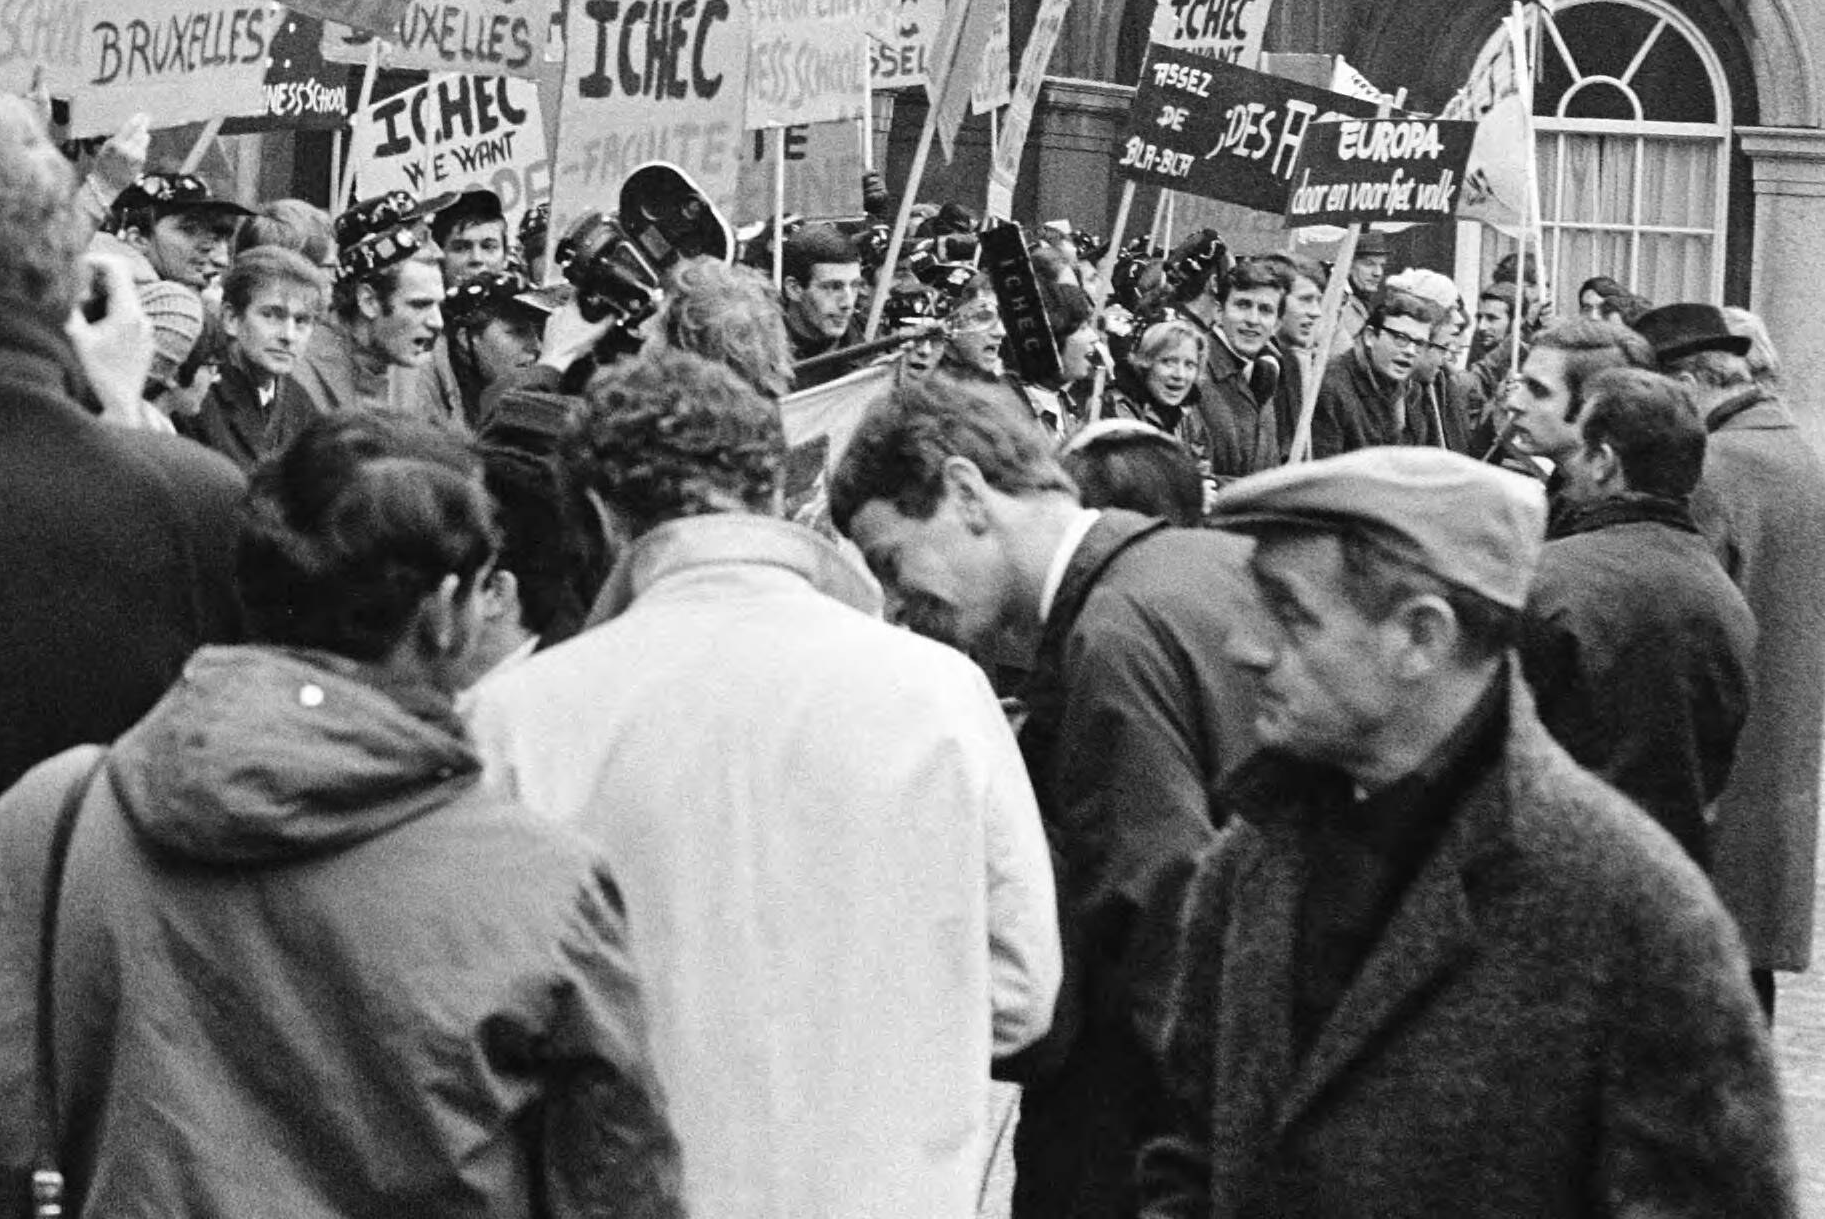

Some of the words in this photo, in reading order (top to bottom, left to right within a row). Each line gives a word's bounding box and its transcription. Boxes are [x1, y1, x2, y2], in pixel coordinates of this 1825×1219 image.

[91, 8, 265, 85] BRUXELLES
[398, 3, 532, 68] UXELLES
[1153, 63, 1214, 98] ASSEZ
[372, 75, 527, 159] ICHEC
[1156, 105, 1190, 132] DE
[1226, 103, 1276, 160] DES
[1338, 121, 1445, 162] EUROPA
[402, 153, 449, 191] WE
[451, 131, 516, 174] WANT
[1119, 135, 1196, 178] BLA-BLA
[1291, 168, 1329, 214] door
[1326, 184, 1349, 211] en
[1349, 182, 1390, 211] voor
[1416, 168, 1456, 214] volk
[1001, 259, 1040, 350] ICHEC
